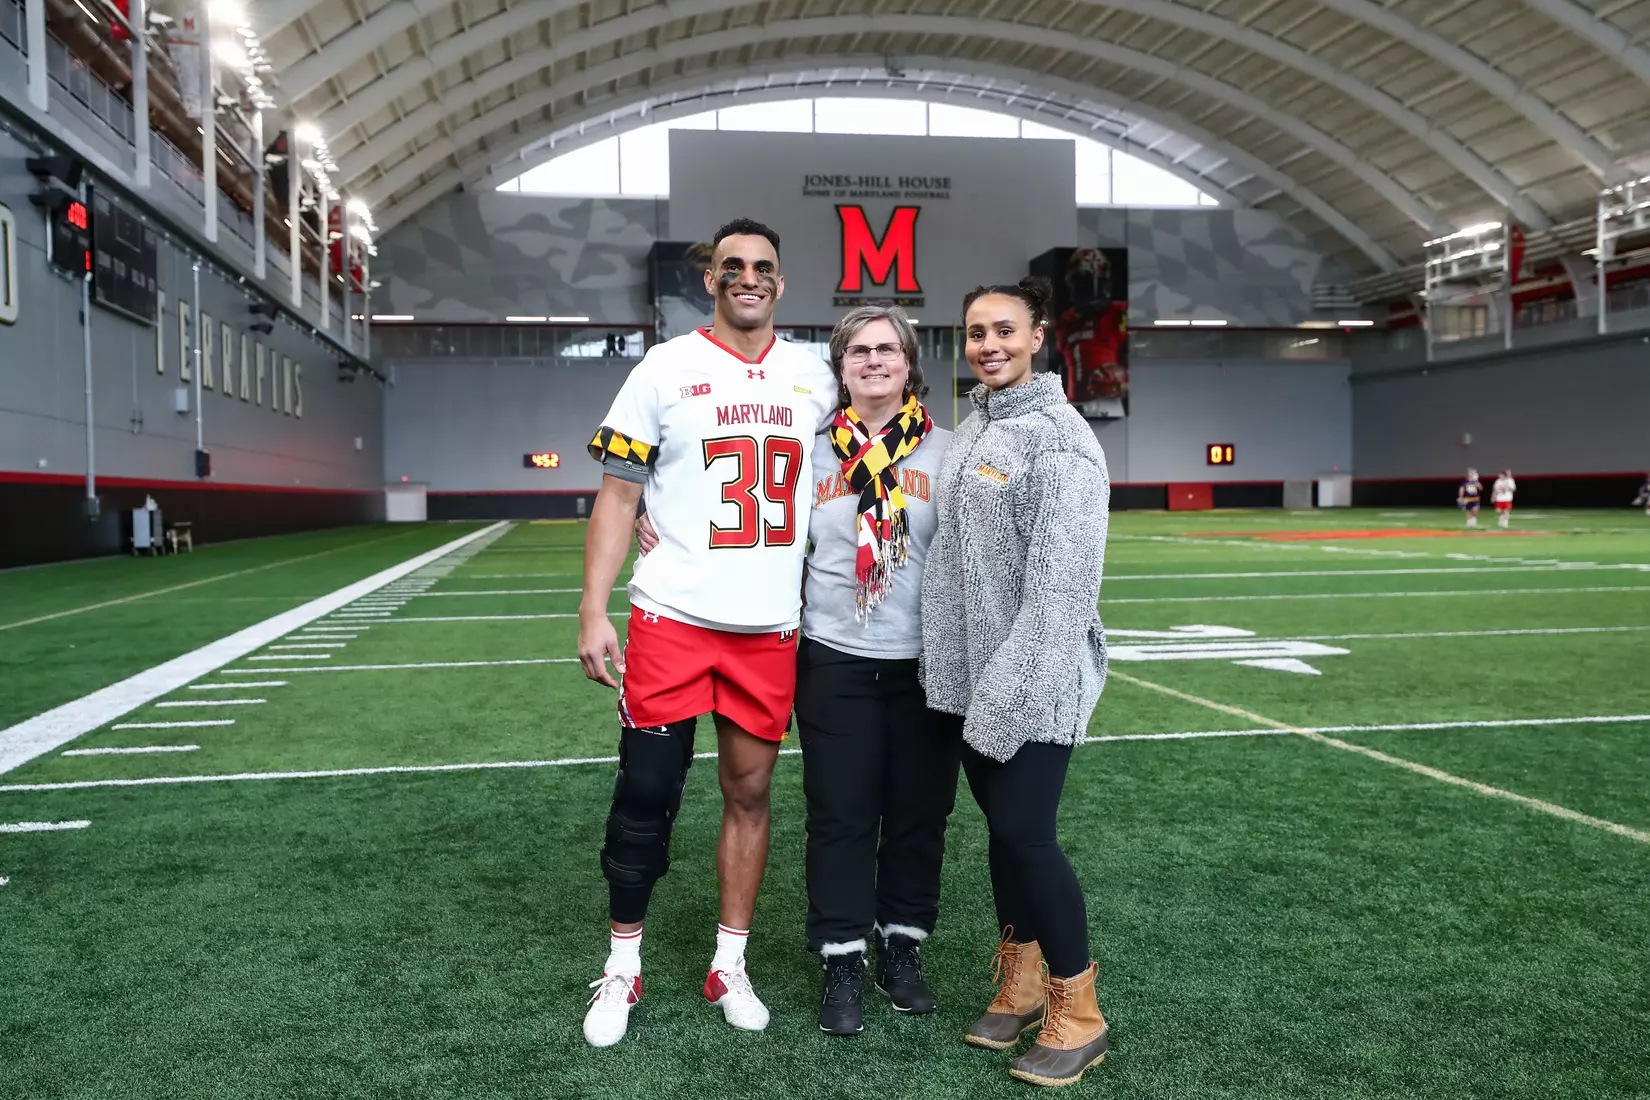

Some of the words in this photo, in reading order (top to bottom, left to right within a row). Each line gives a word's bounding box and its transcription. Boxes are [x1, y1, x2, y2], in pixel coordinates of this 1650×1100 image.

[802, 189, 830, 197] HOME
[904, 191, 951, 199] FOOTBALL
[803, 175, 891, 189] JONES-HILL
[899, 176, 952, 189] HOUSE
[834, 204, 923, 294] M
[157, 289, 303, 420] TERRAPINS
[716, 404, 793, 427] MARYLAND
[702, 435, 804, 549] 39
